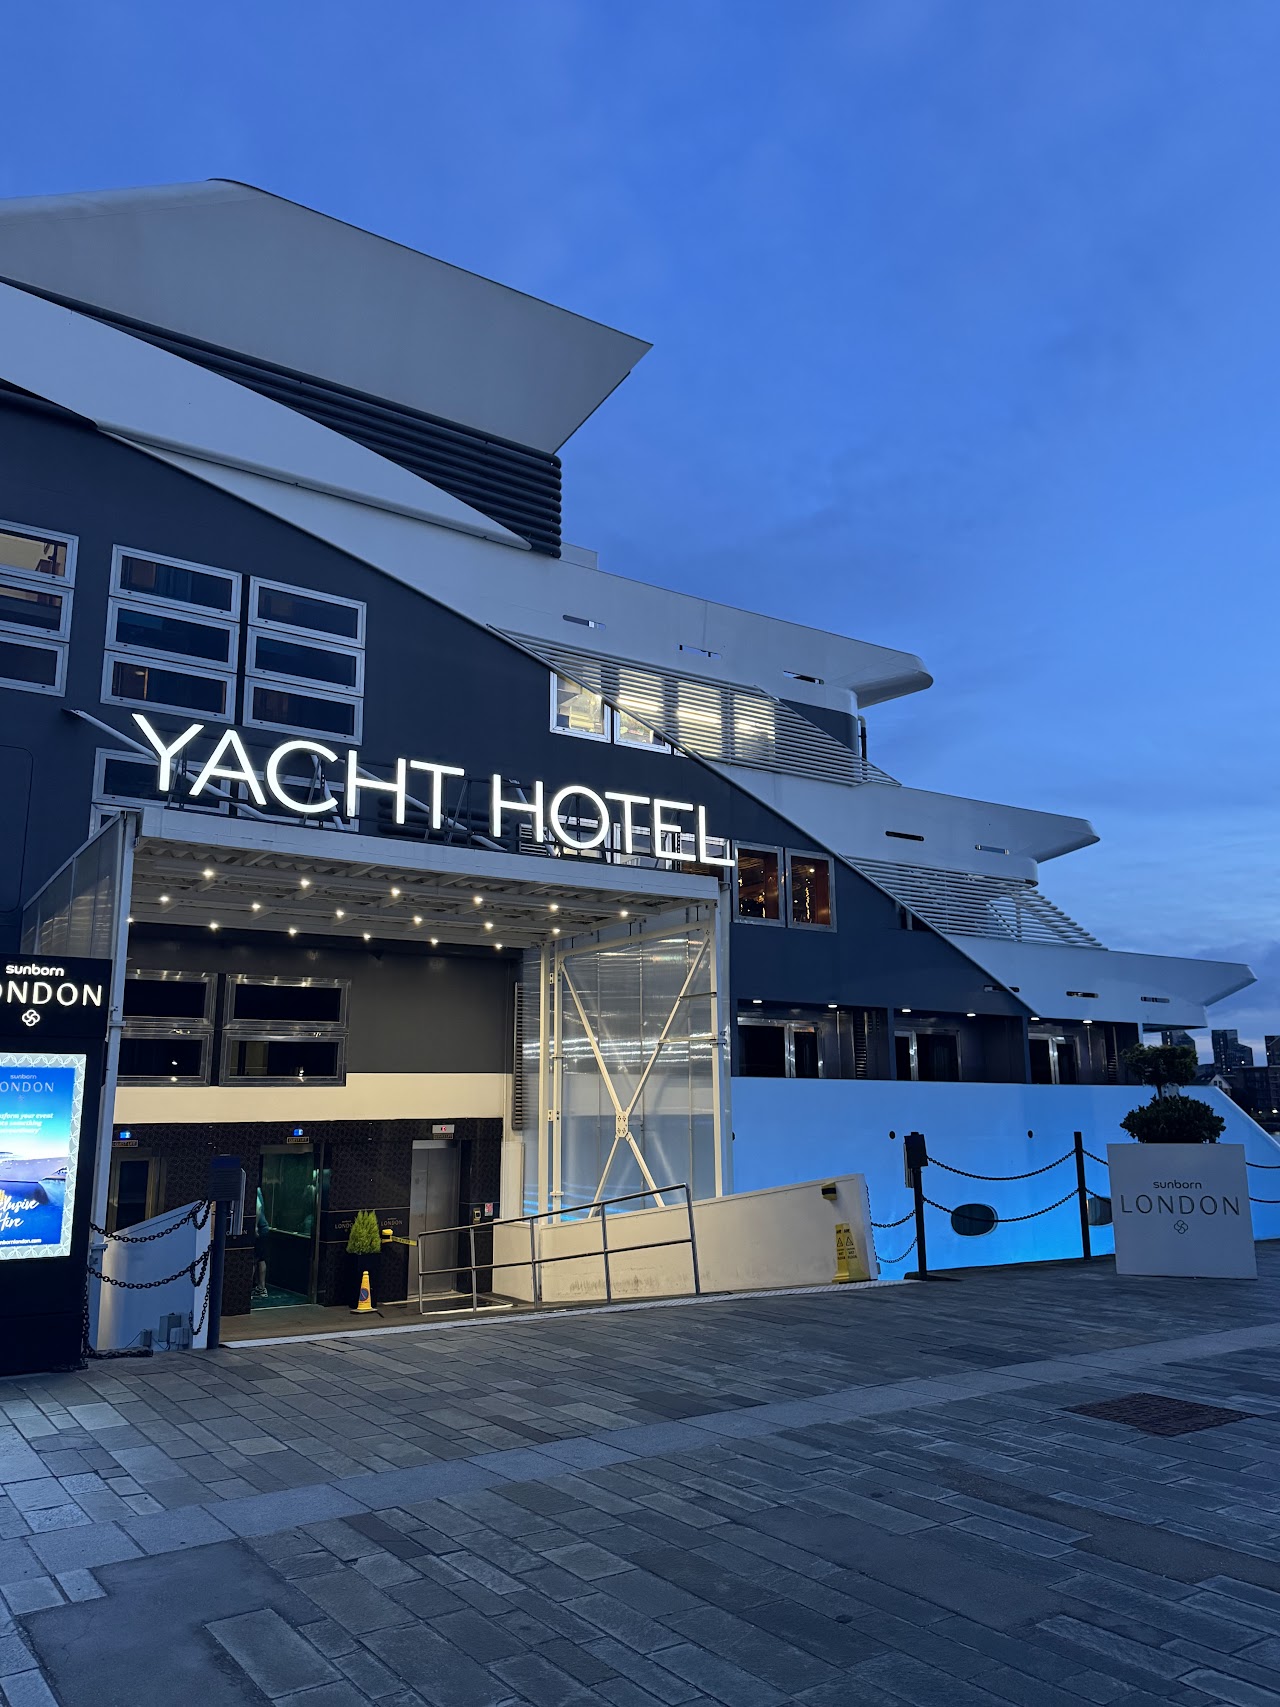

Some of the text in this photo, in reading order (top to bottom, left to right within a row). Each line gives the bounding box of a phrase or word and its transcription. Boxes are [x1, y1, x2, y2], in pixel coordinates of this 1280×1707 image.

[132, 713, 736, 868] YACHT HOTEL
[5, 964, 65, 977] sunborn
[0, 980, 102, 1007] NDON
[0, 1081, 54, 1093] ONDON
[1153, 1179, 1202, 1190] sunborn
[1120, 1194, 1240, 1216] LONDON
[334, 1222, 354, 1230] LONDO
